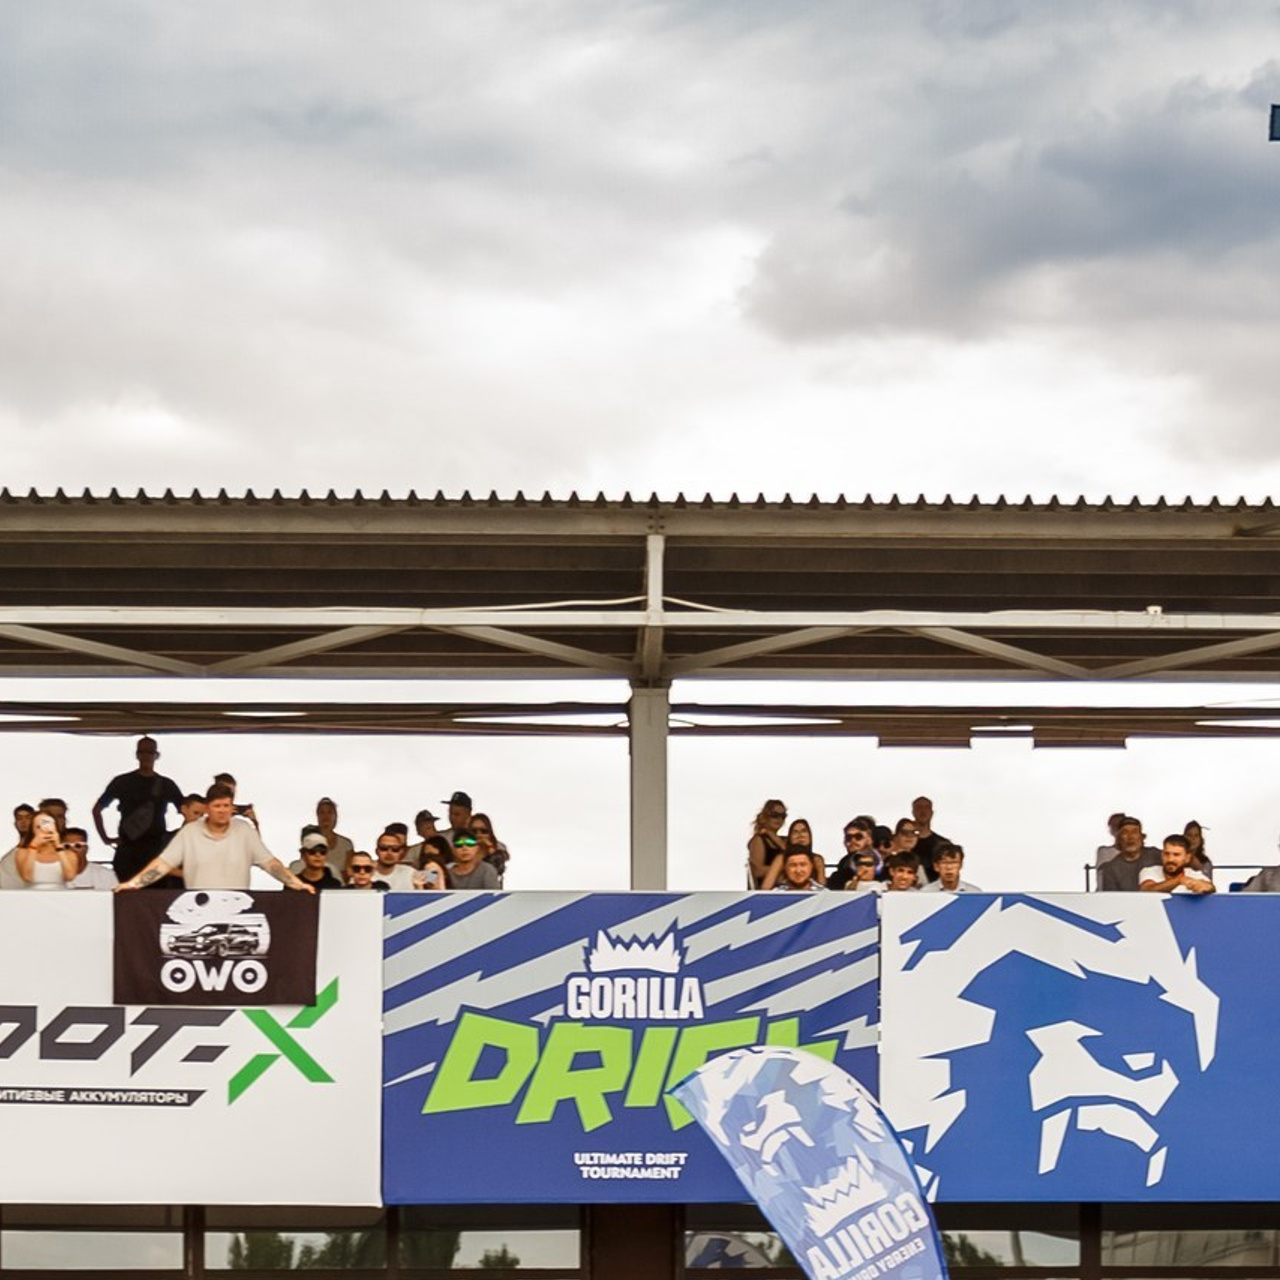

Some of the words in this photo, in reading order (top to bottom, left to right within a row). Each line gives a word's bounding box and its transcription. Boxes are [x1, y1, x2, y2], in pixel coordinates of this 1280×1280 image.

[160, 960, 268, 993] OWO
[567, 977, 704, 1019] GORILLA
[69, 1090, 189, 1105] АККУМУЛЯТОРЫ
[574, 1152, 643, 1166] ULTIMATE
[644, 1152, 689, 1166] DRIFT
[579, 1166, 683, 1179] TOURNAMENT
